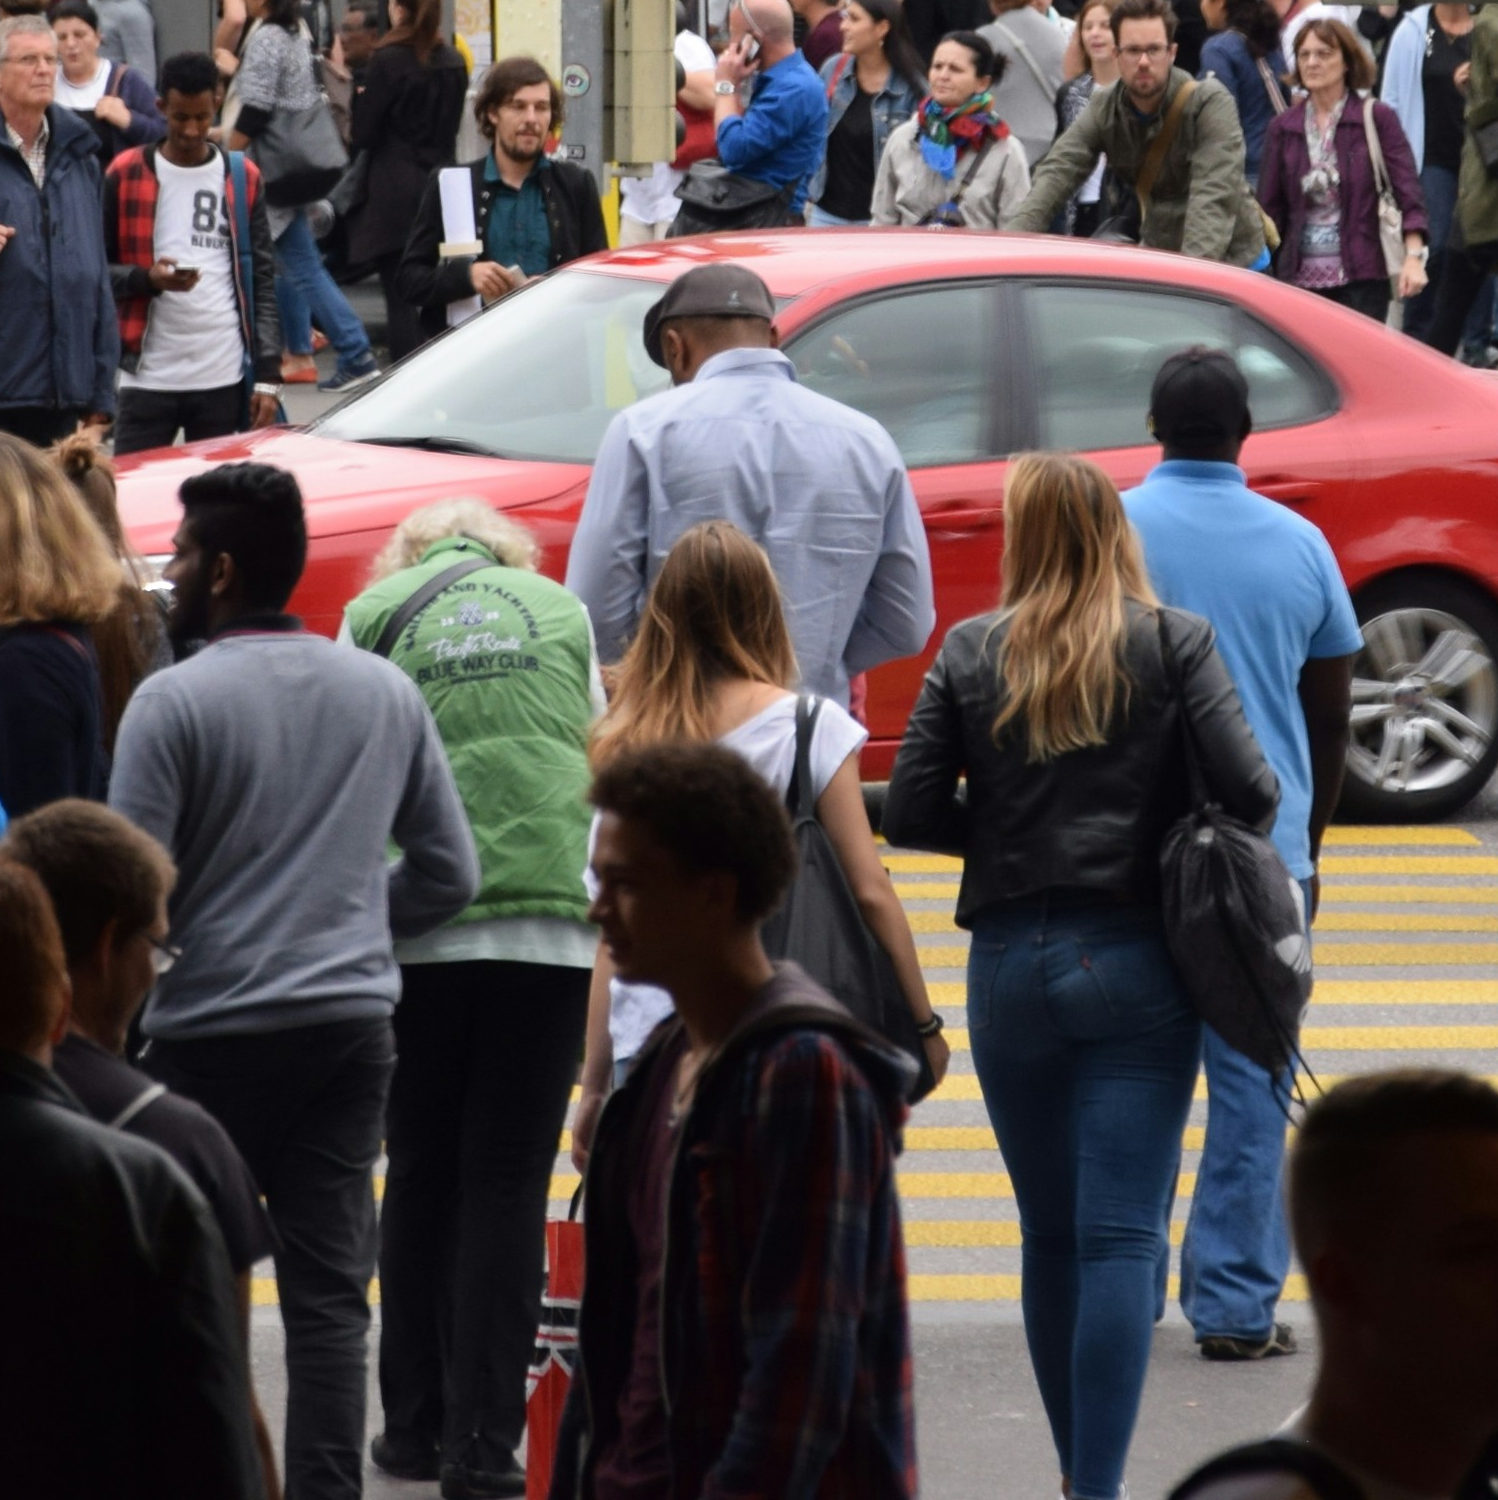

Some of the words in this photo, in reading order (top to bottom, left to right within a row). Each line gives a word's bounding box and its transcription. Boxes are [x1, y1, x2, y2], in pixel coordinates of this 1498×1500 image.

[416, 659, 458, 684] BLUE
[461, 654, 495, 672] WAY
[499, 653, 541, 672] CLUB
